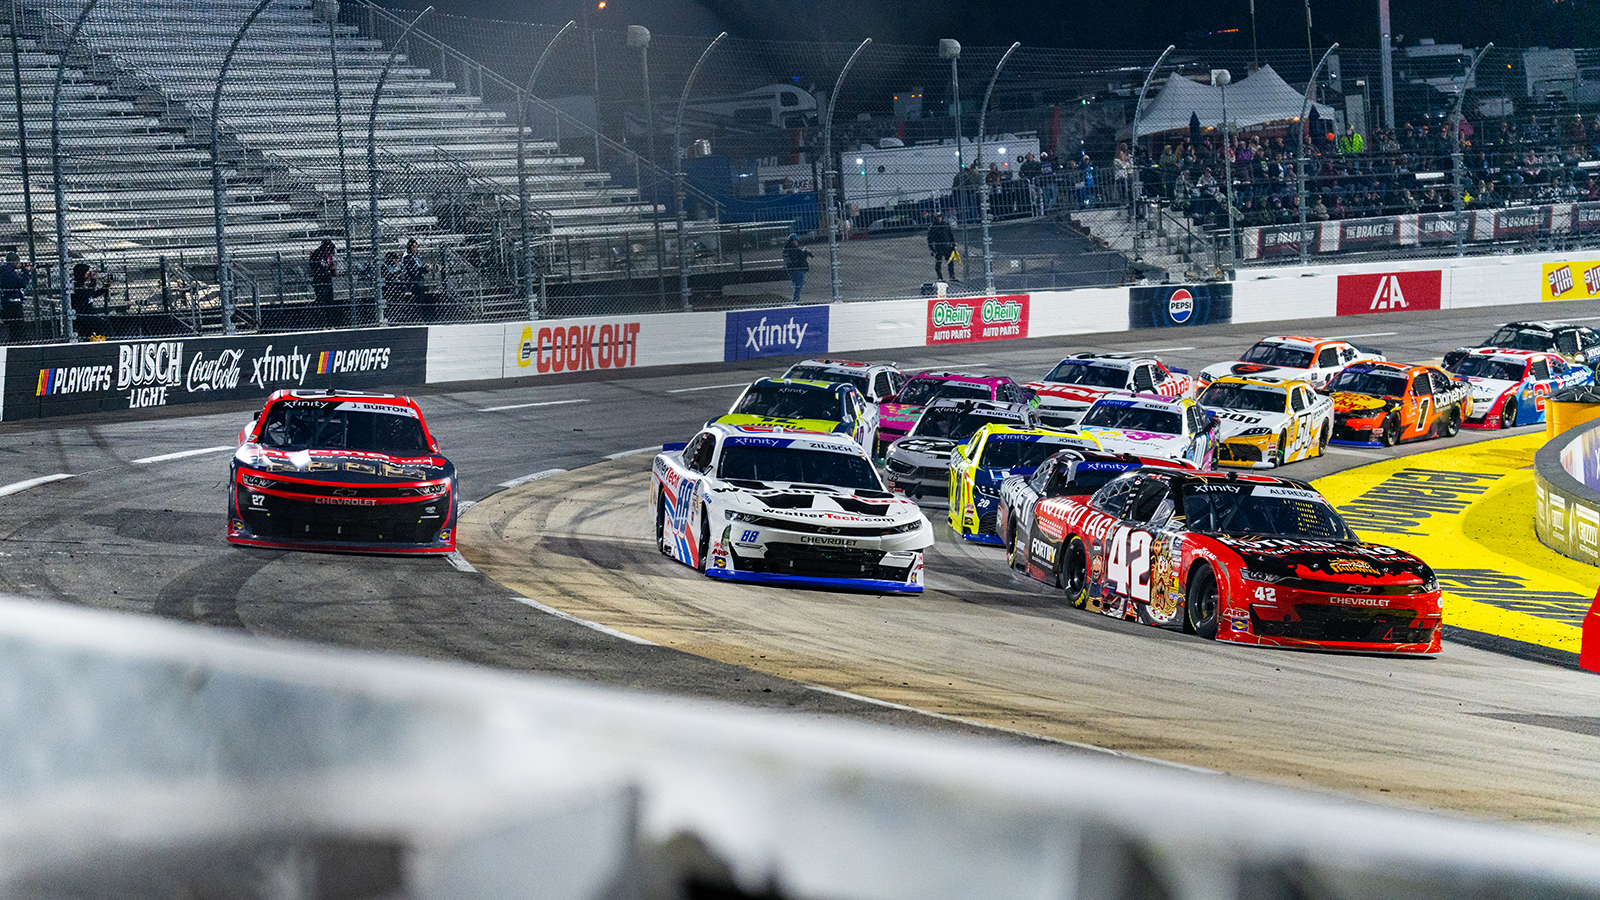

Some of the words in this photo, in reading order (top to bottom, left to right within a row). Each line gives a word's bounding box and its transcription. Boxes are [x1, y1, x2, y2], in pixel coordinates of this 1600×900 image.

[1277, 231, 1302, 244] BRAK
[1356, 224, 1384, 238] BRAKE
[984, 301, 1020, 321] O'Reilly
[1170, 302, 1191, 310] PEPSI
[934, 304, 972, 325] O'Reilly
[745, 316, 808, 352] xfinity
[933, 330, 950, 341] AUTO
[951, 328, 971, 340] PARTS
[982, 327, 999, 338] AUTO
[1000, 325, 1020, 336] PARTS
[536, 324, 596, 374] COOK
[597, 322, 640, 369] OUT
[116, 342, 184, 391] BUSCH
[250, 344, 312, 389] xfinity
[332, 347, 391, 374] PLAYOFFS
[53, 365, 113, 395] PLAYOFFS
[129, 387, 168, 408] LIGHT
[283, 400, 329, 409] xfinity
[364, 403, 408, 414] BURTON
[1144, 403, 1169, 411] CREED
[987, 411, 1020, 419] BURTON
[1416, 396, 1431, 432] 1
[734, 437, 780, 447] xfinity
[996, 434, 1031, 442] xfinity
[1058, 437, 1084, 446] JONES
[809, 442, 853, 453] ZILISCH
[1087, 462, 1129, 471] xfinity
[1194, 483, 1242, 495] xfinity
[1269, 488, 1314, 499] ALFREDO
[251, 494, 265, 506] 27
[314, 496, 378, 507] CHEVROLET
[762, 508, 895, 523] WeatherTech.com
[1082, 511, 1113, 540] TAG
[740, 530, 760, 543] 88
[800, 536, 858, 547] CHEVROLET
[1107, 525, 1153, 602] 42
[1253, 586, 1277, 603] 42
[1329, 596, 1391, 608] CHEVROLET
[1223, 607, 1250, 619] ARP
